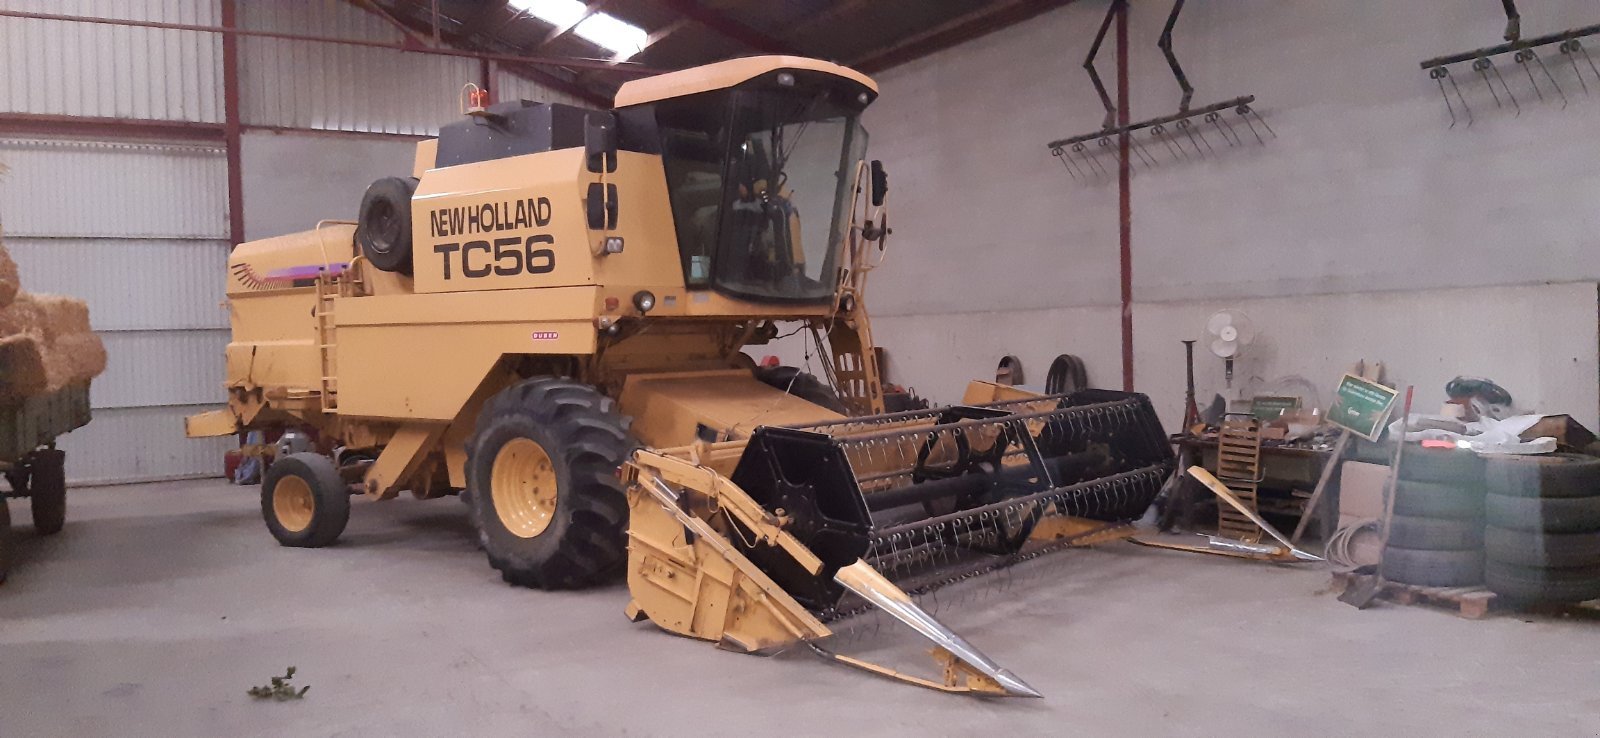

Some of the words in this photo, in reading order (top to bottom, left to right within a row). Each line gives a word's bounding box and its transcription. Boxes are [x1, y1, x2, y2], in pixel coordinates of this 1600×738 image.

[430, 206, 465, 237] NEW
[468, 196, 552, 234] HOLLAND
[433, 234, 556, 280] TC56
